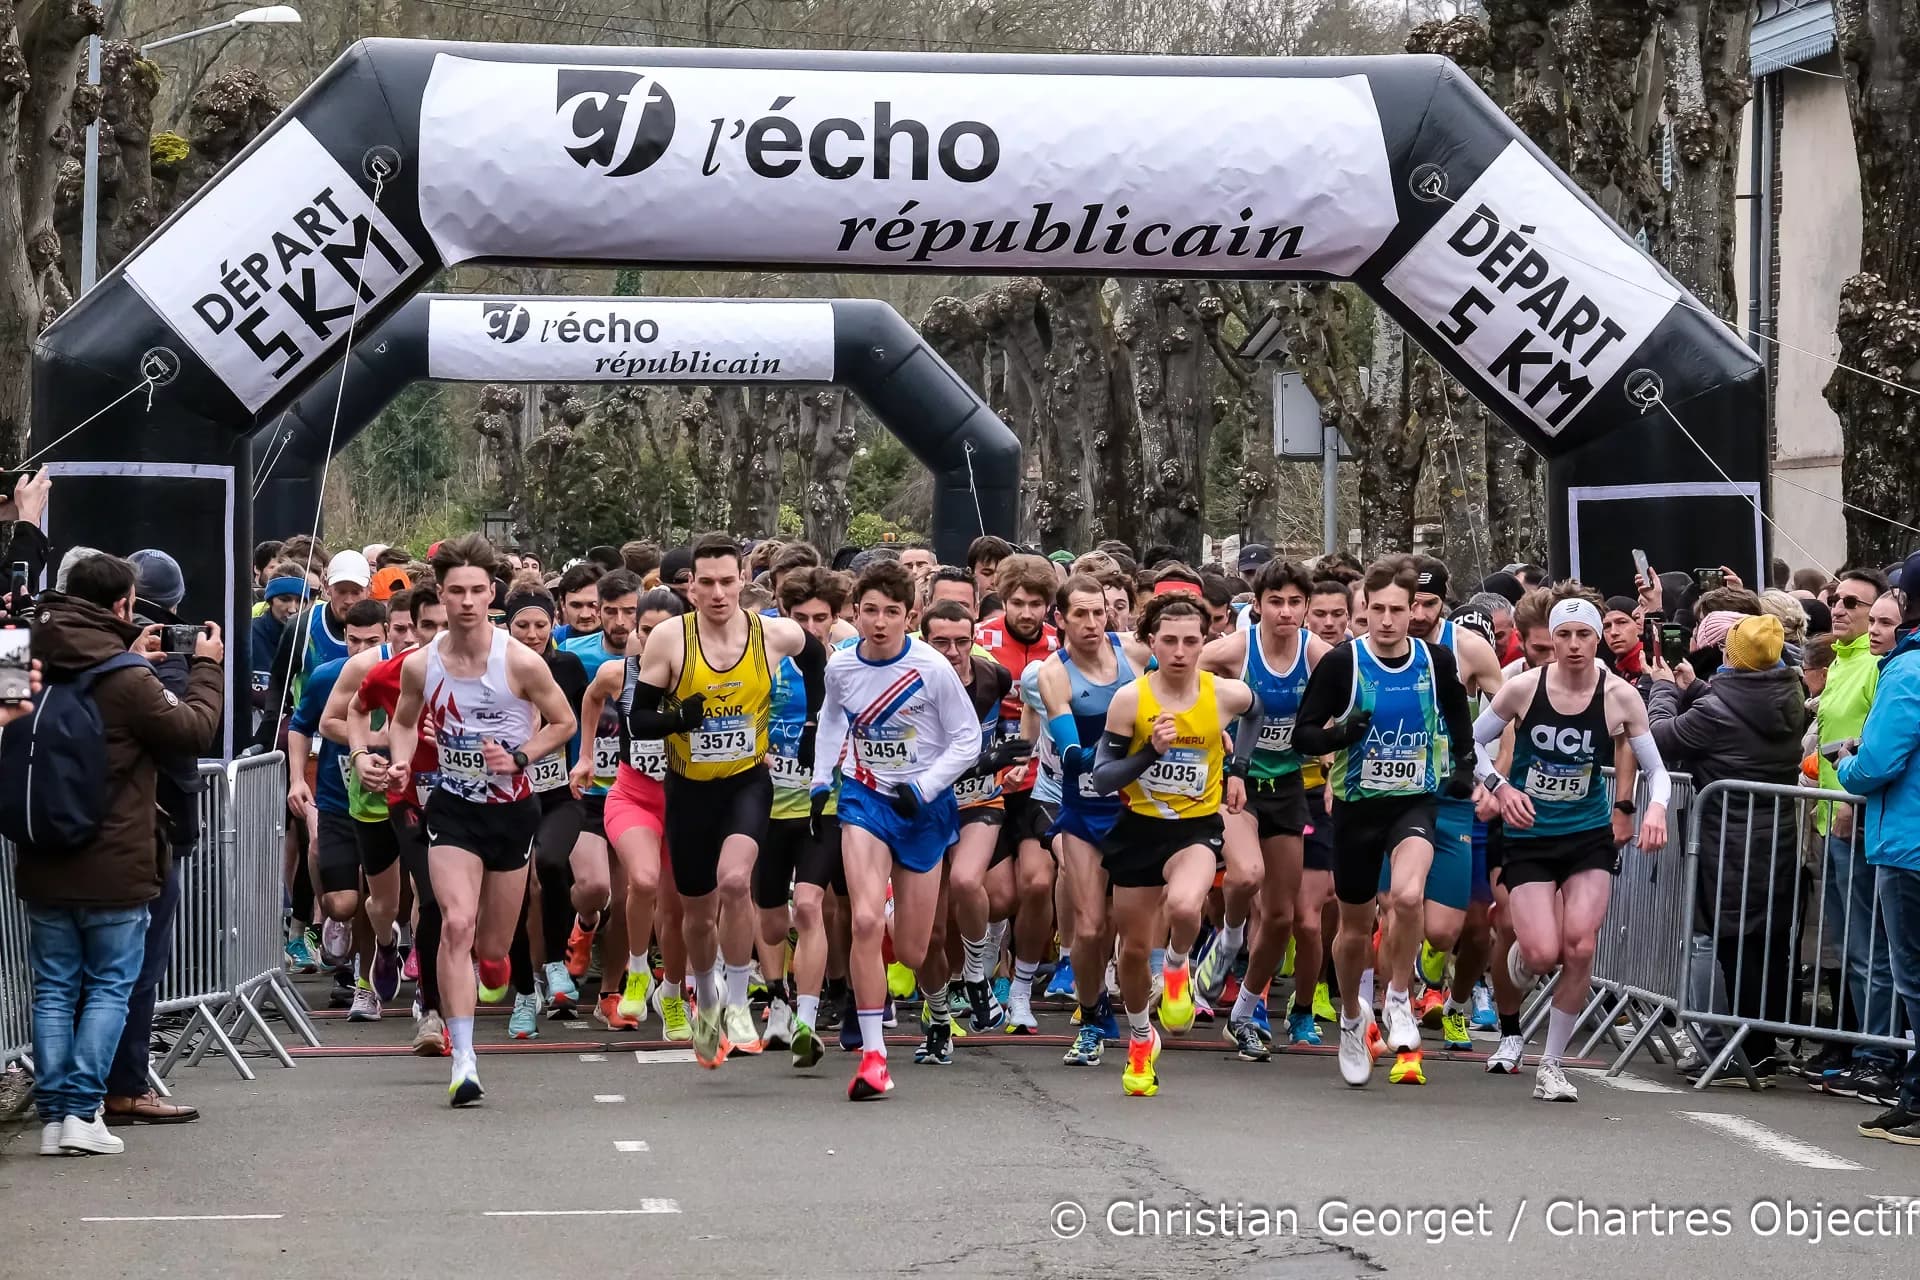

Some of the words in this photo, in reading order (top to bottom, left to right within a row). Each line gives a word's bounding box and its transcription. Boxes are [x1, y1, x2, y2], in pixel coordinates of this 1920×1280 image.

[701, 96, 1000, 182] l'écho
[836, 200, 1304, 262] républicain
[192, 187, 349, 335] DÉPART
[234, 306, 304, 380] 5
[278, 214, 409, 341] KM
[1447, 203, 1627, 367] DÉPART
[540, 311, 659, 344] l'écho
[594, 350, 781, 378] républicain
[1436, 286, 1496, 346] 5
[1487, 328, 1595, 428] KM
[703, 704, 744, 718] ASNR
[700, 731, 746, 750] 3573
[863, 741, 908, 758] 3454
[443, 748, 485, 769] 3459
[774, 758, 813, 777] 314
[1371, 761, 1416, 778] 3390
[1150, 762, 1197, 782] 3035
[1535, 774, 1580, 791] 3215
